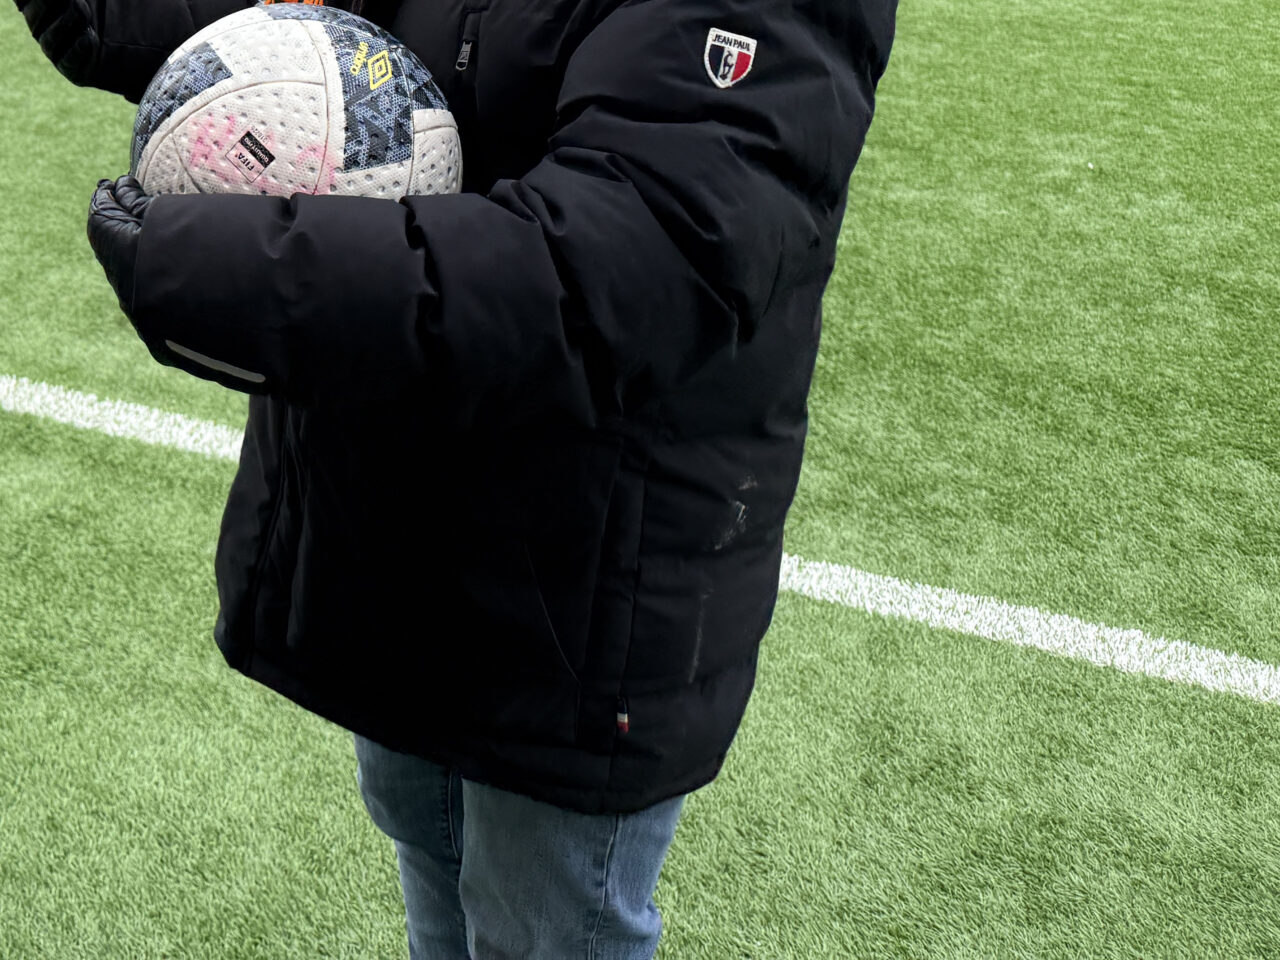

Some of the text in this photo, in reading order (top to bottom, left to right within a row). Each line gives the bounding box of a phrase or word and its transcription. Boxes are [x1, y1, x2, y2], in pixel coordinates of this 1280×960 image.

[712, 34, 750, 51] JEAN PAUL
[349, 41, 369, 76] umbro
[237, 152, 255, 171] FIFA
[252, 145, 269, 163] QUALITY
